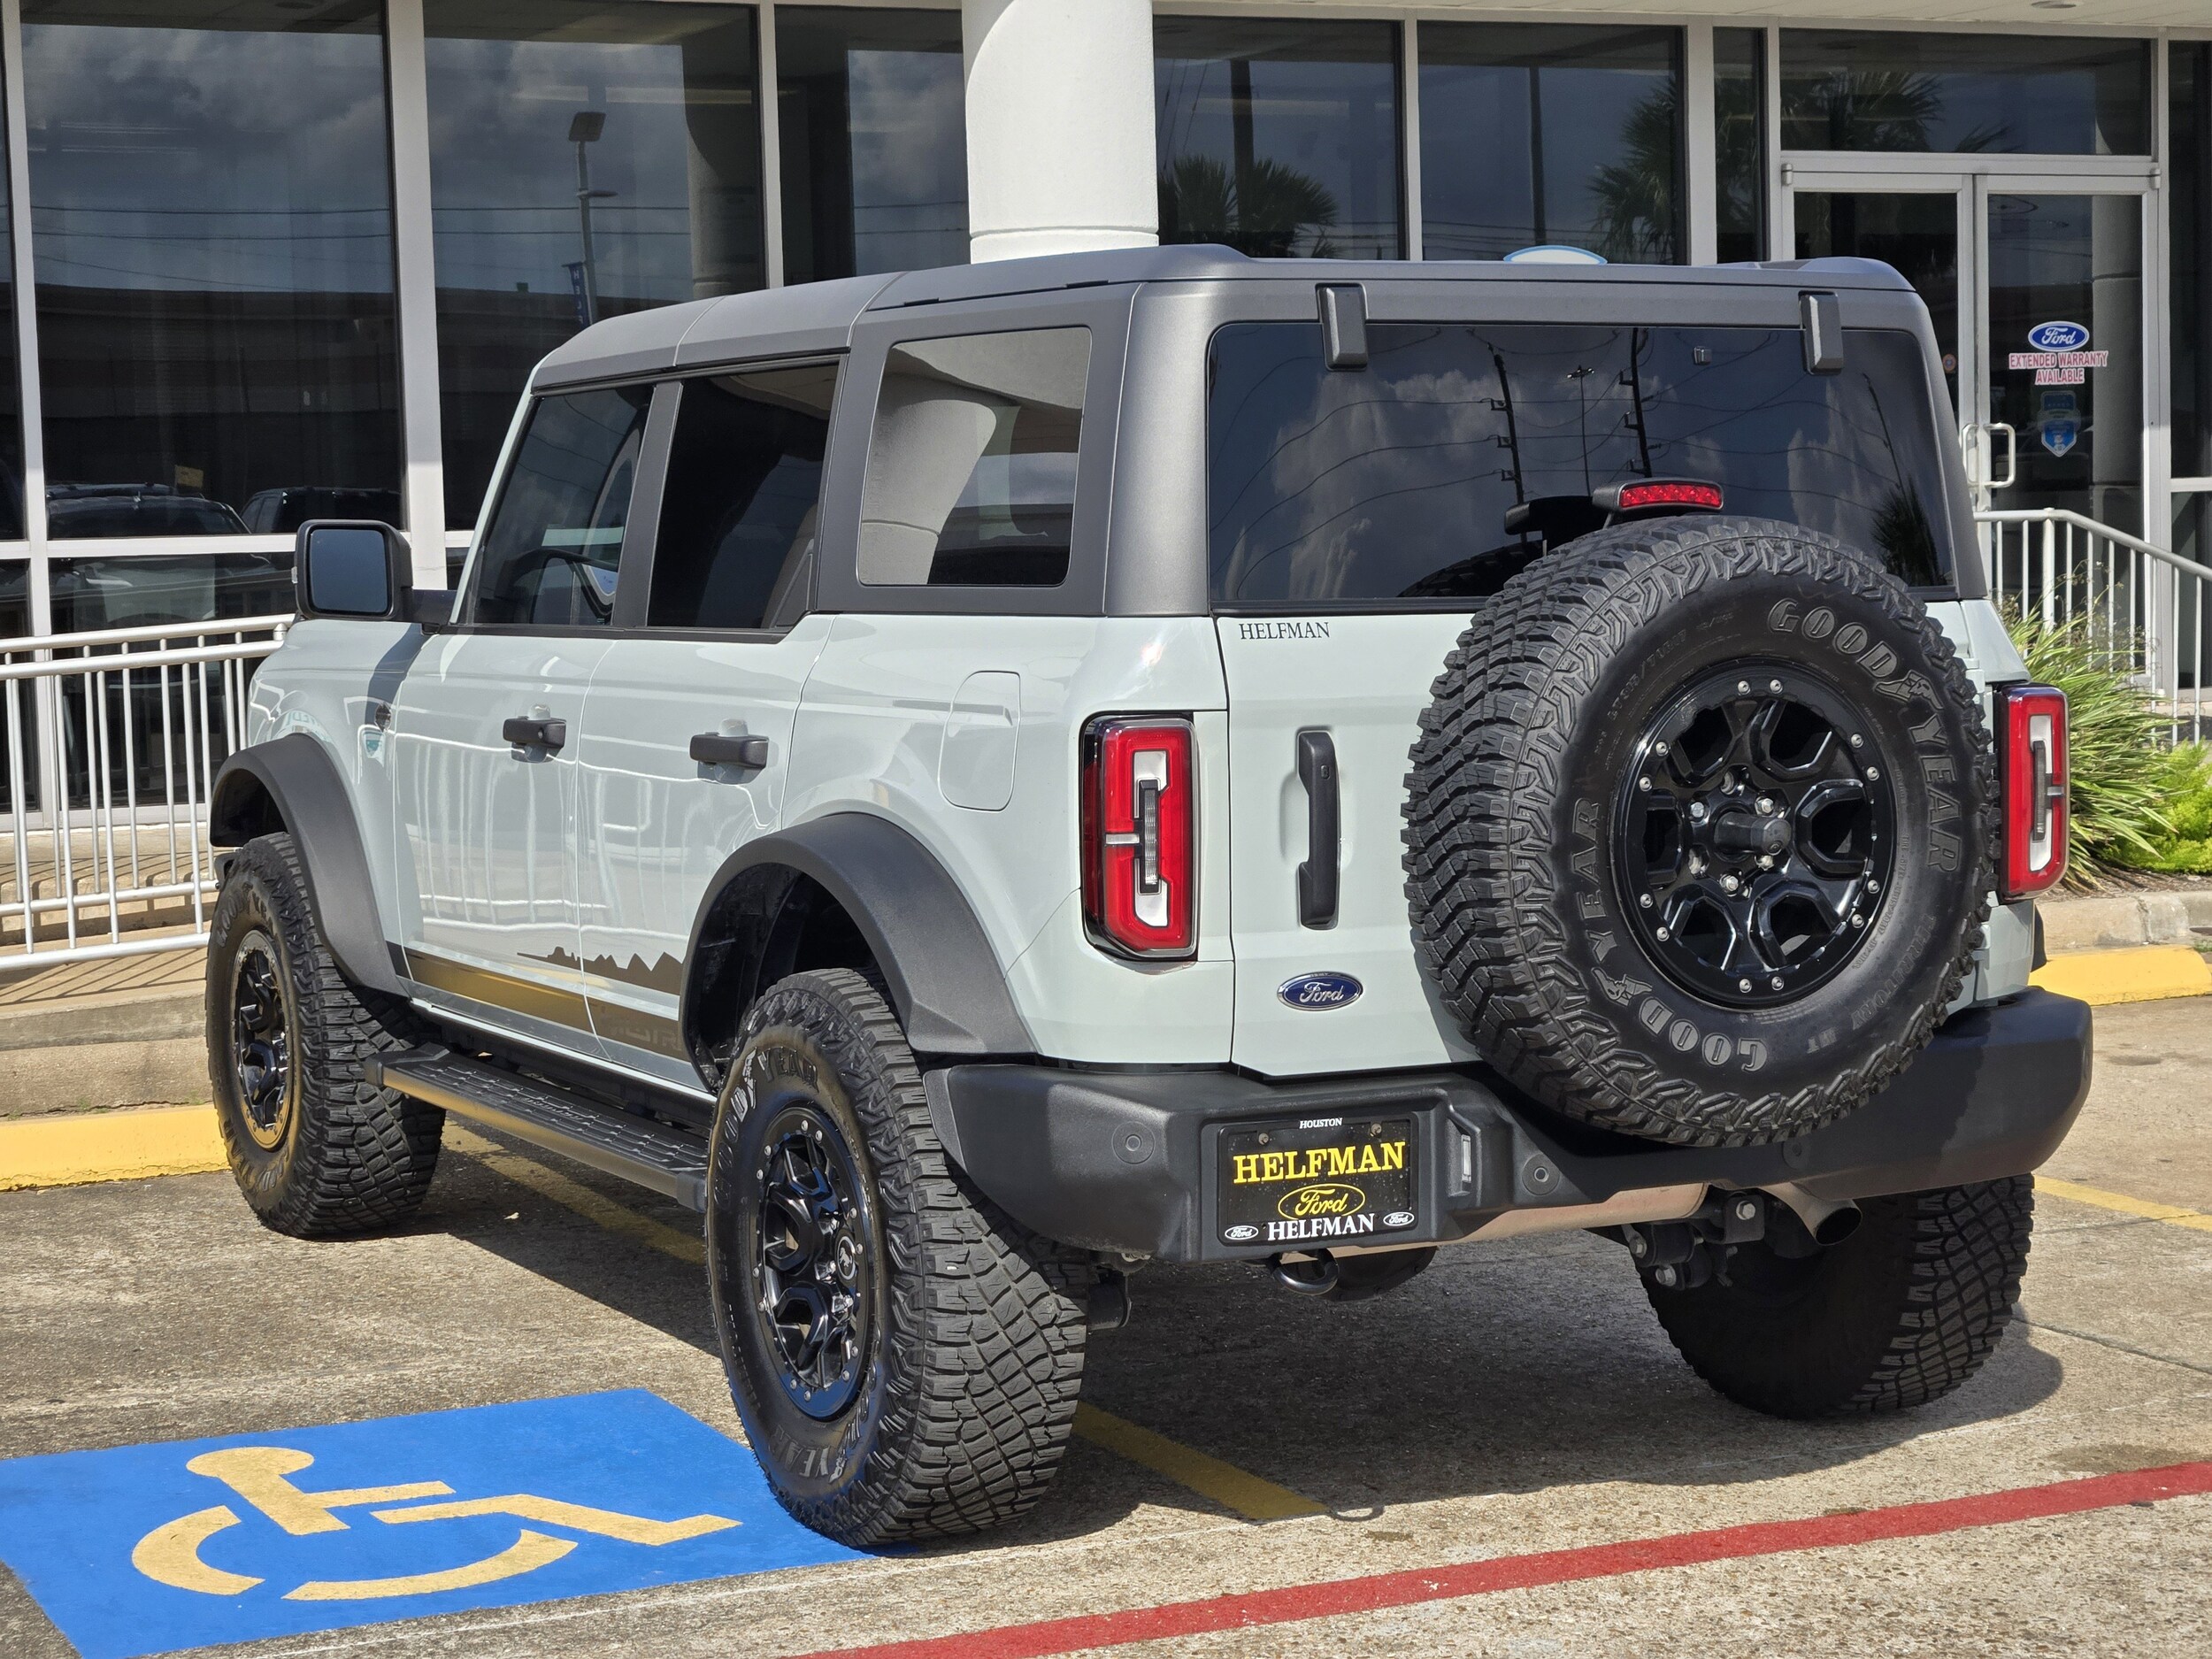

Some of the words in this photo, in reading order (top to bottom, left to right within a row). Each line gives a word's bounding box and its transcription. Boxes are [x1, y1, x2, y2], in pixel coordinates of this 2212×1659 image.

[2041, 326, 2077, 345] Ford
[2009, 353, 2056, 369] EXTENDED
[2059, 351, 2108, 367] WARRANTY
[2035, 369, 2085, 385] AVAILABLE
[1239, 622, 1330, 640] HELFMAN
[1299, 981, 1344, 1002] Ford
[1299, 1118, 1343, 1129] HOUSTON
[1233, 1141, 1406, 1184] HELFMAN
[1294, 1188, 1349, 1217] Ford
[1267, 1213, 1376, 1241] HELFMAN
